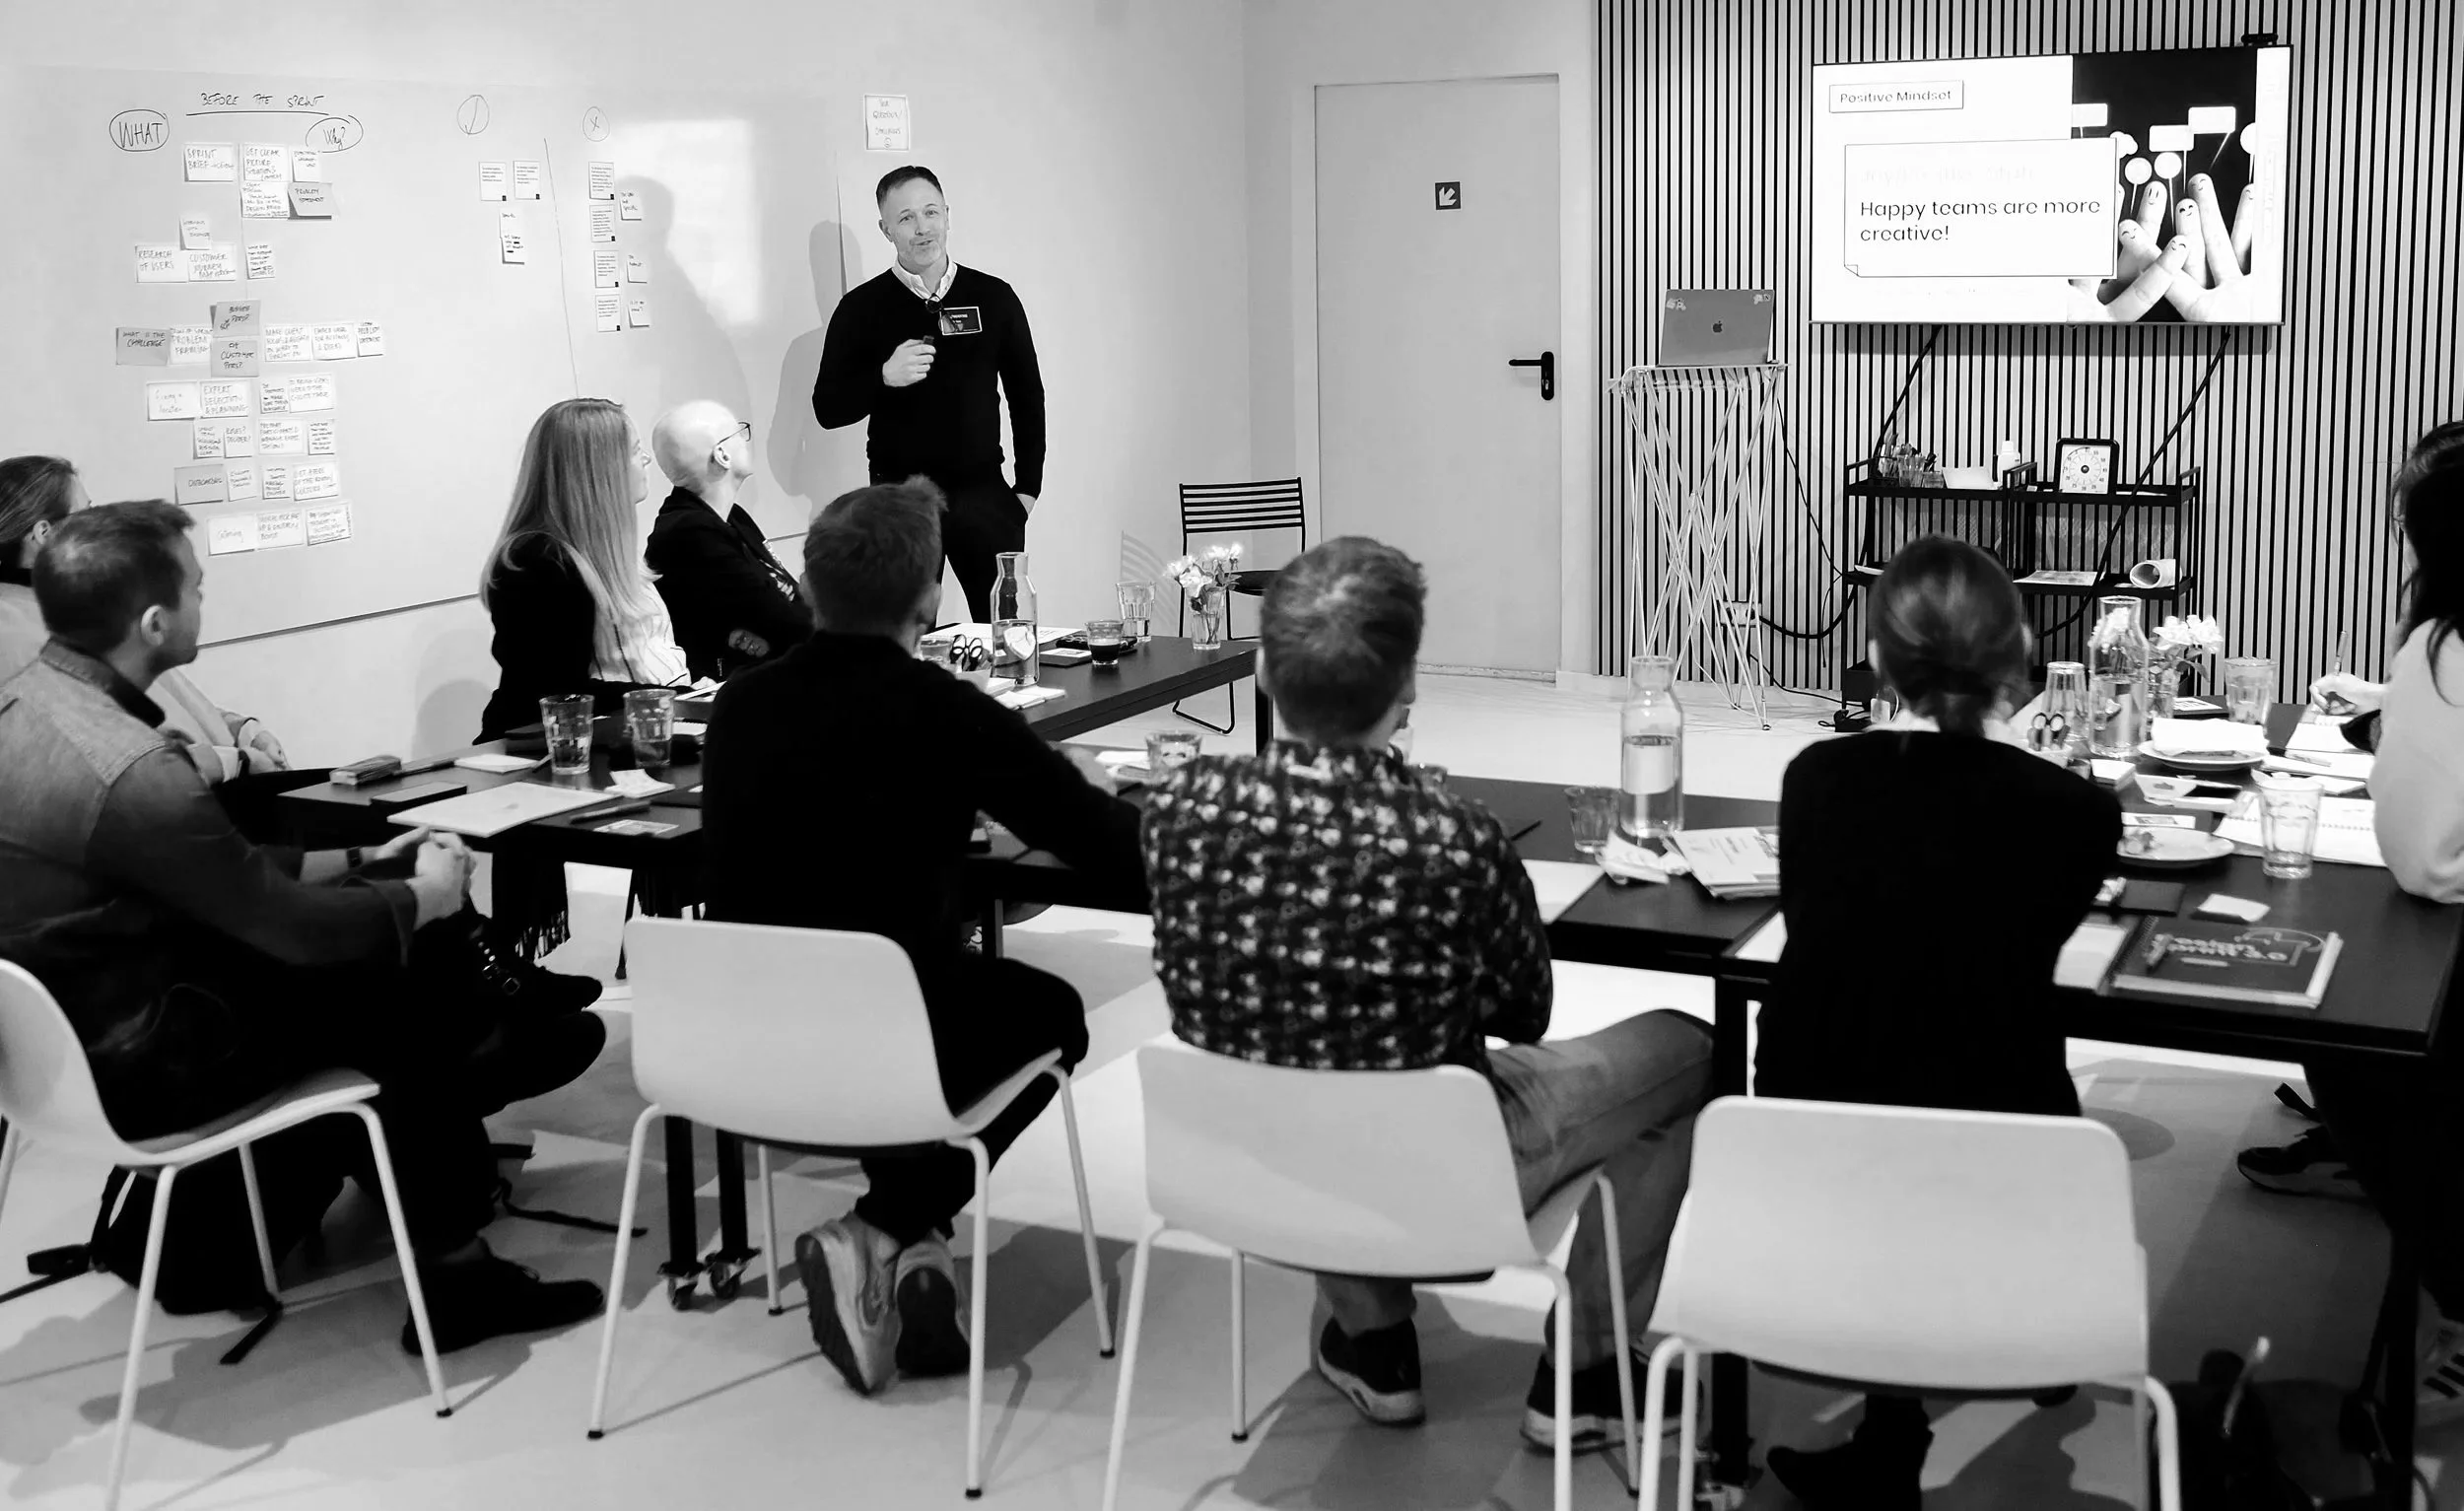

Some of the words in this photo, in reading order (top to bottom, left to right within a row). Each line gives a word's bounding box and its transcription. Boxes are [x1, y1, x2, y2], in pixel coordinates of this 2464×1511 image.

[200, 93, 240, 106] BEFORE
[252, 93, 273, 104] THE
[287, 95, 325, 107] SPRINT
[1840, 93, 1893, 103] Positive
[1896, 91, 1952, 102] Mindset
[118, 120, 163, 148] WHAT
[187, 148, 217, 159] SPRINT
[1860, 201, 1926, 221] Happy
[1932, 200, 1998, 216] teams
[2003, 201, 2038, 215] are
[2044, 200, 2101, 215] more
[1860, 224, 1950, 241] creative!
[127, 338, 166, 348] CHALLENGE
